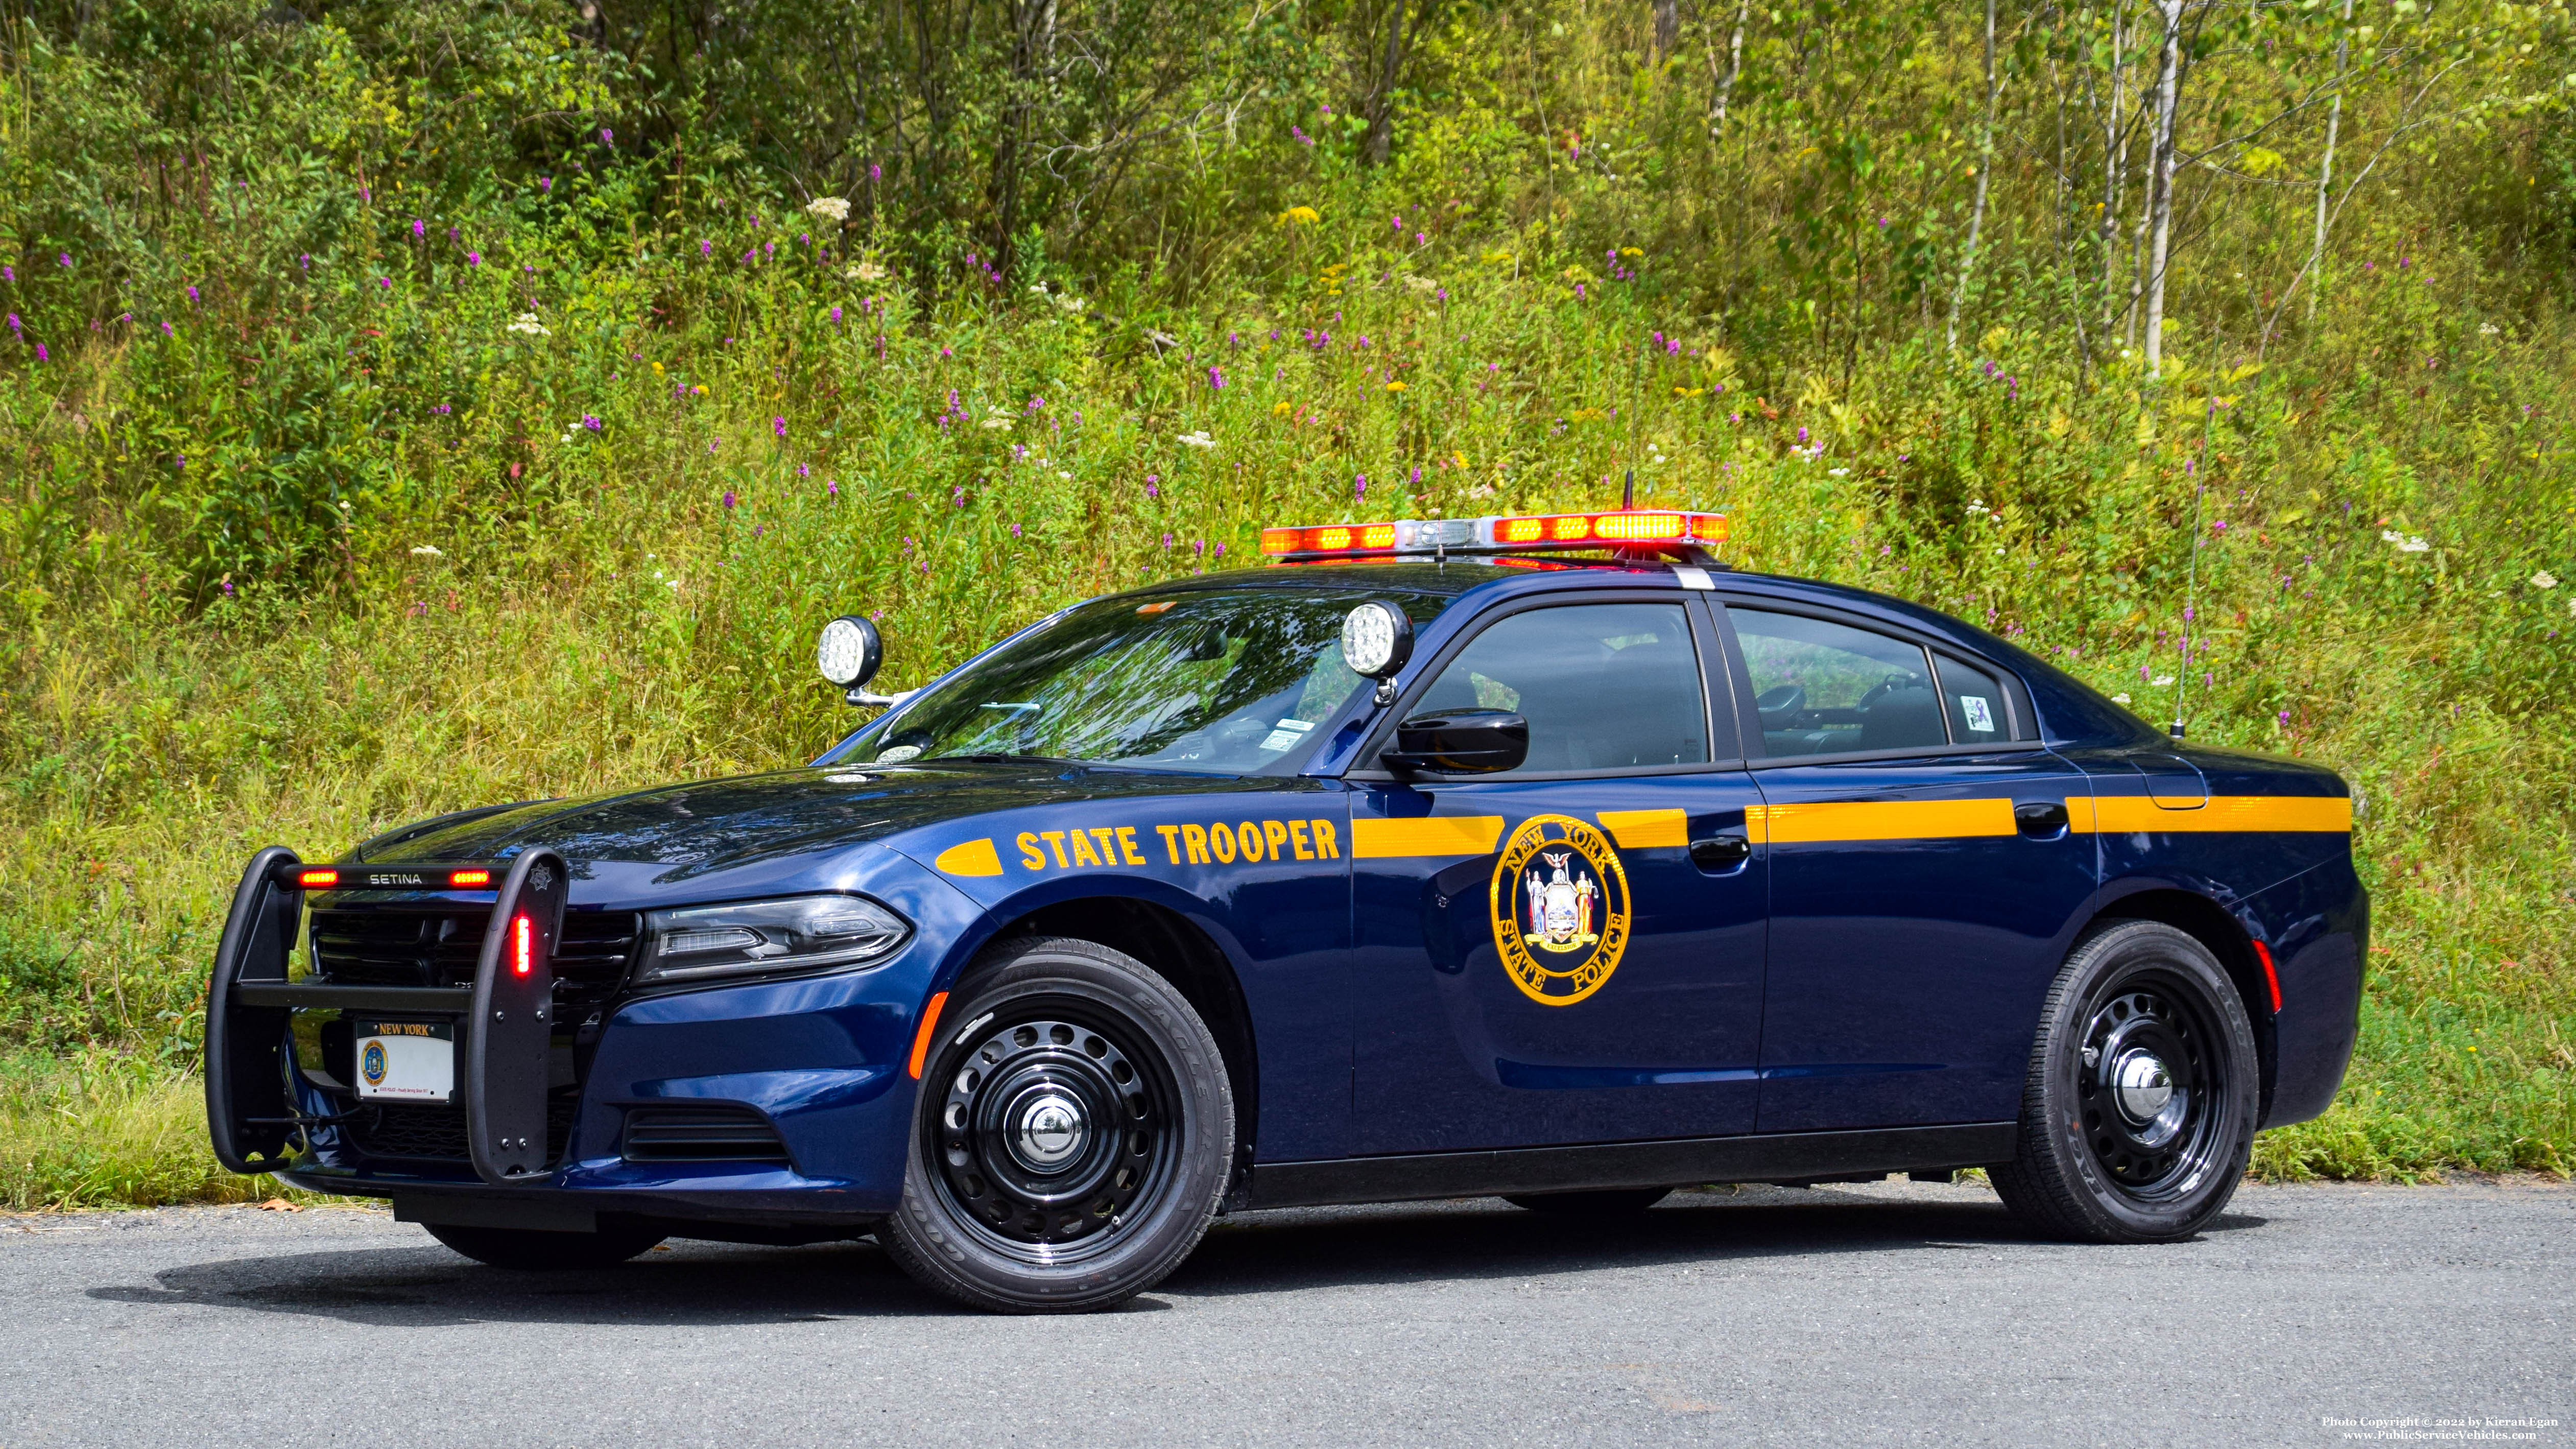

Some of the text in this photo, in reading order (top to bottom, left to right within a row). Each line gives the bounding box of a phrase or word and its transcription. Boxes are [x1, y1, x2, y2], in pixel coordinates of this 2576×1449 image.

[1016, 819, 1340, 870] STATE TROOPER
[1504, 823, 1611, 875] NEW YORK
[370, 874, 422, 884] SETINA
[1499, 912, 1625, 993] STATE POLICE
[379, 1024, 429, 1036] NEW YORK
[1130, 991, 1210, 1101] EAGLE
